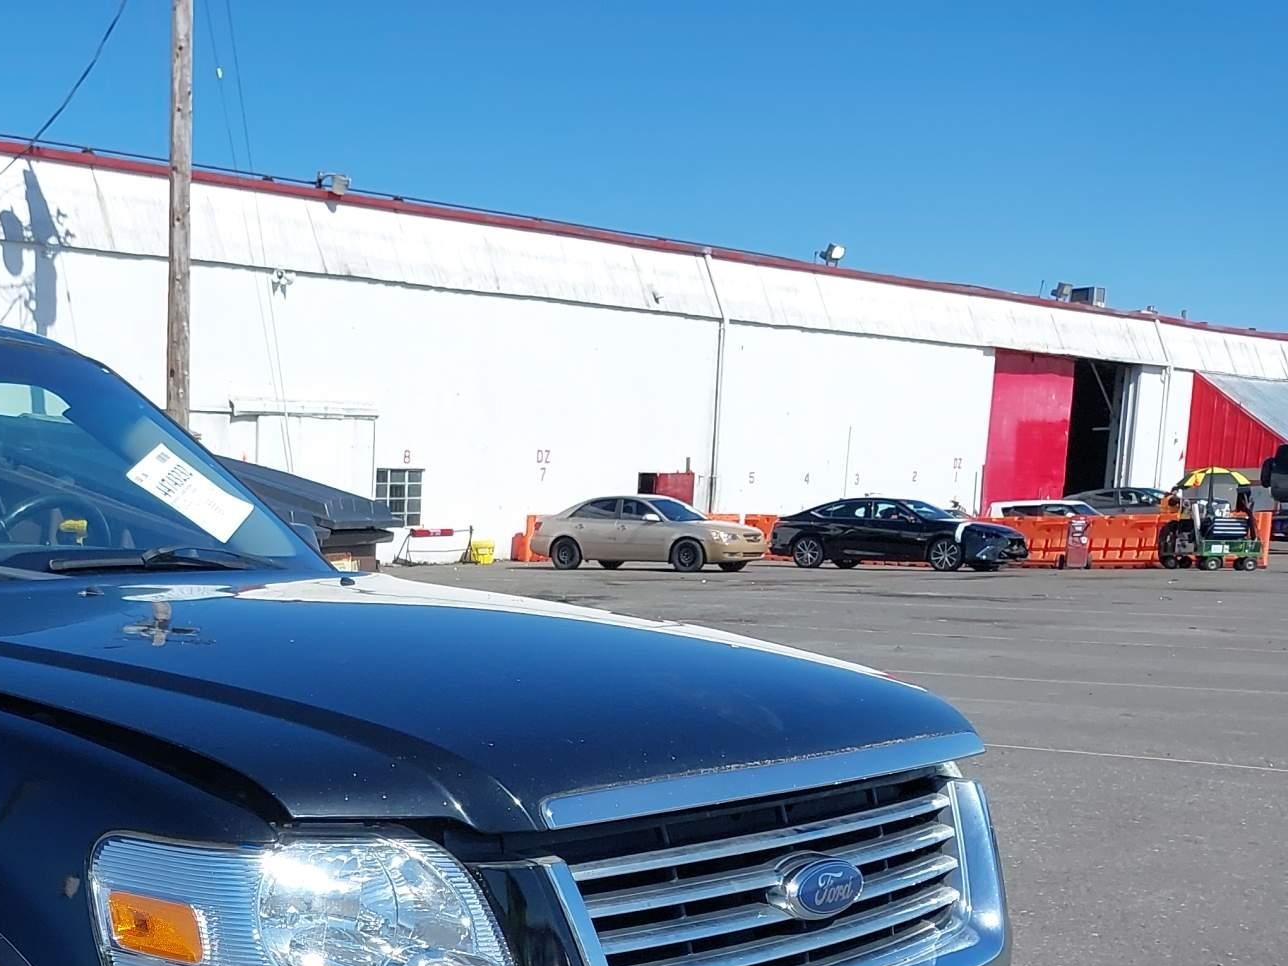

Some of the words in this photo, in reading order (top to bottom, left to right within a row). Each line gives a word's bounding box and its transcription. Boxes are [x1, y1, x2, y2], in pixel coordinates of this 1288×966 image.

[403, 449, 411, 465] 8
[540, 467, 547, 482] 7
[748, 471, 756, 485] 5
[803, 472, 810, 485] 4
[854, 473, 860, 486] 3
[911, 470, 918, 483] 2
[814, 871, 854, 906] Ford
